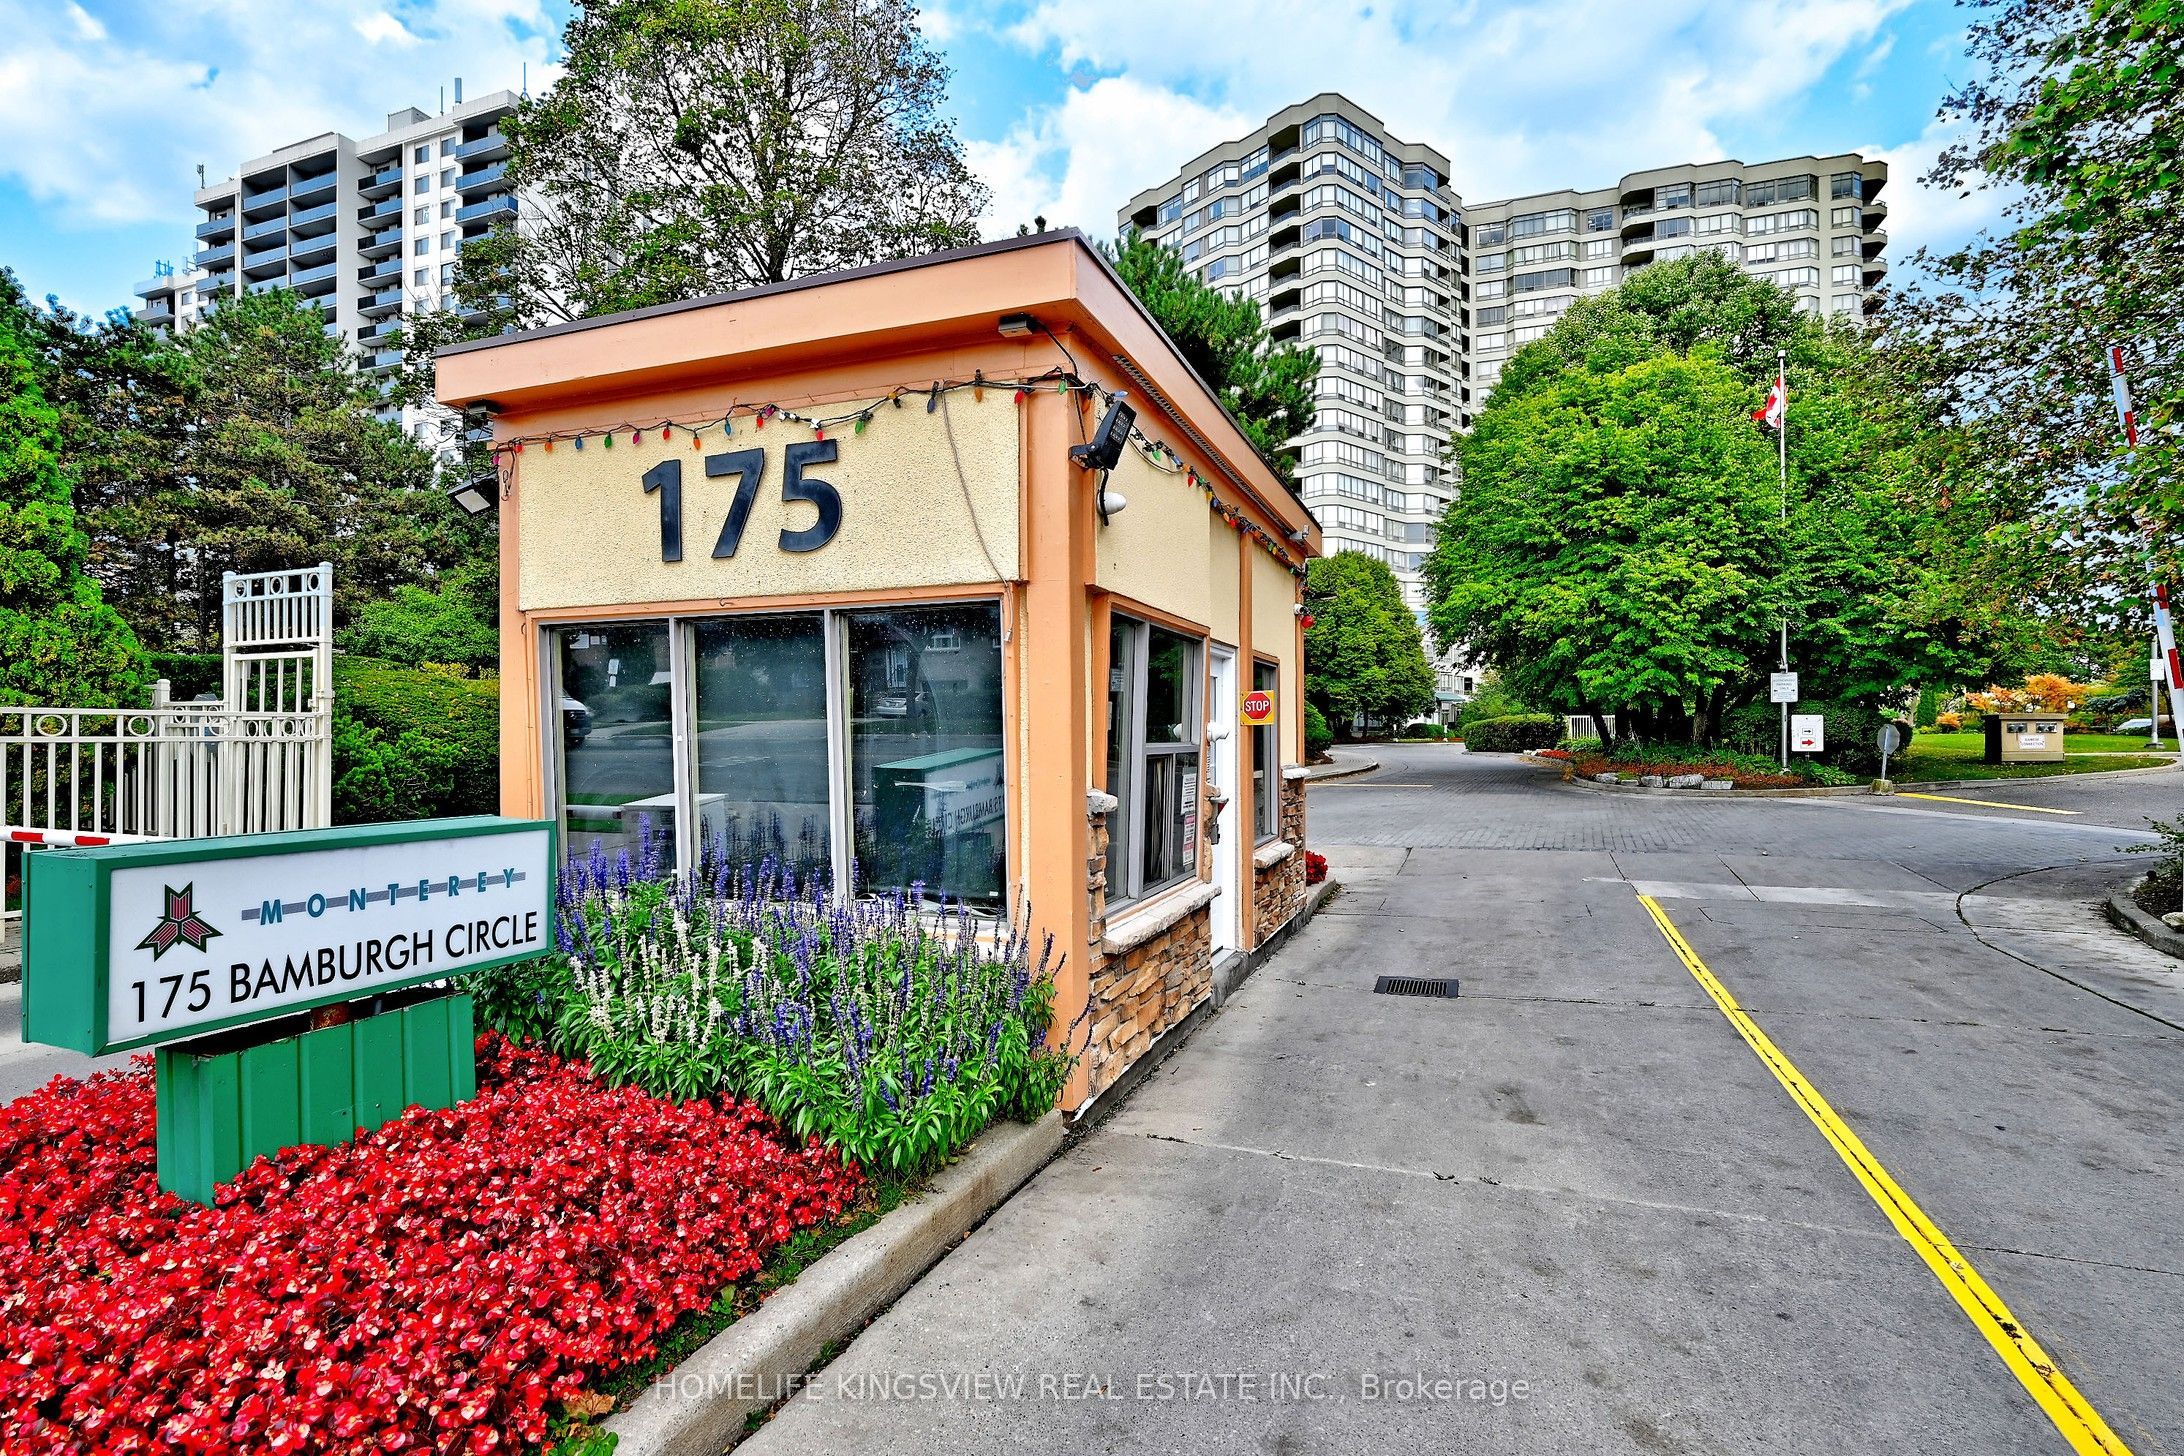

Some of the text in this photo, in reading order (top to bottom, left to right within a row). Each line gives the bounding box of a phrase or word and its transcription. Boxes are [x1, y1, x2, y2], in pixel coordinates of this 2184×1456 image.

[641, 438, 843, 562] 175
[1245, 700, 1270, 712] STOP
[259, 867, 516, 926] MONTEREY
[131, 910, 538, 1023] 175 BAMBURGH CIRCLE
